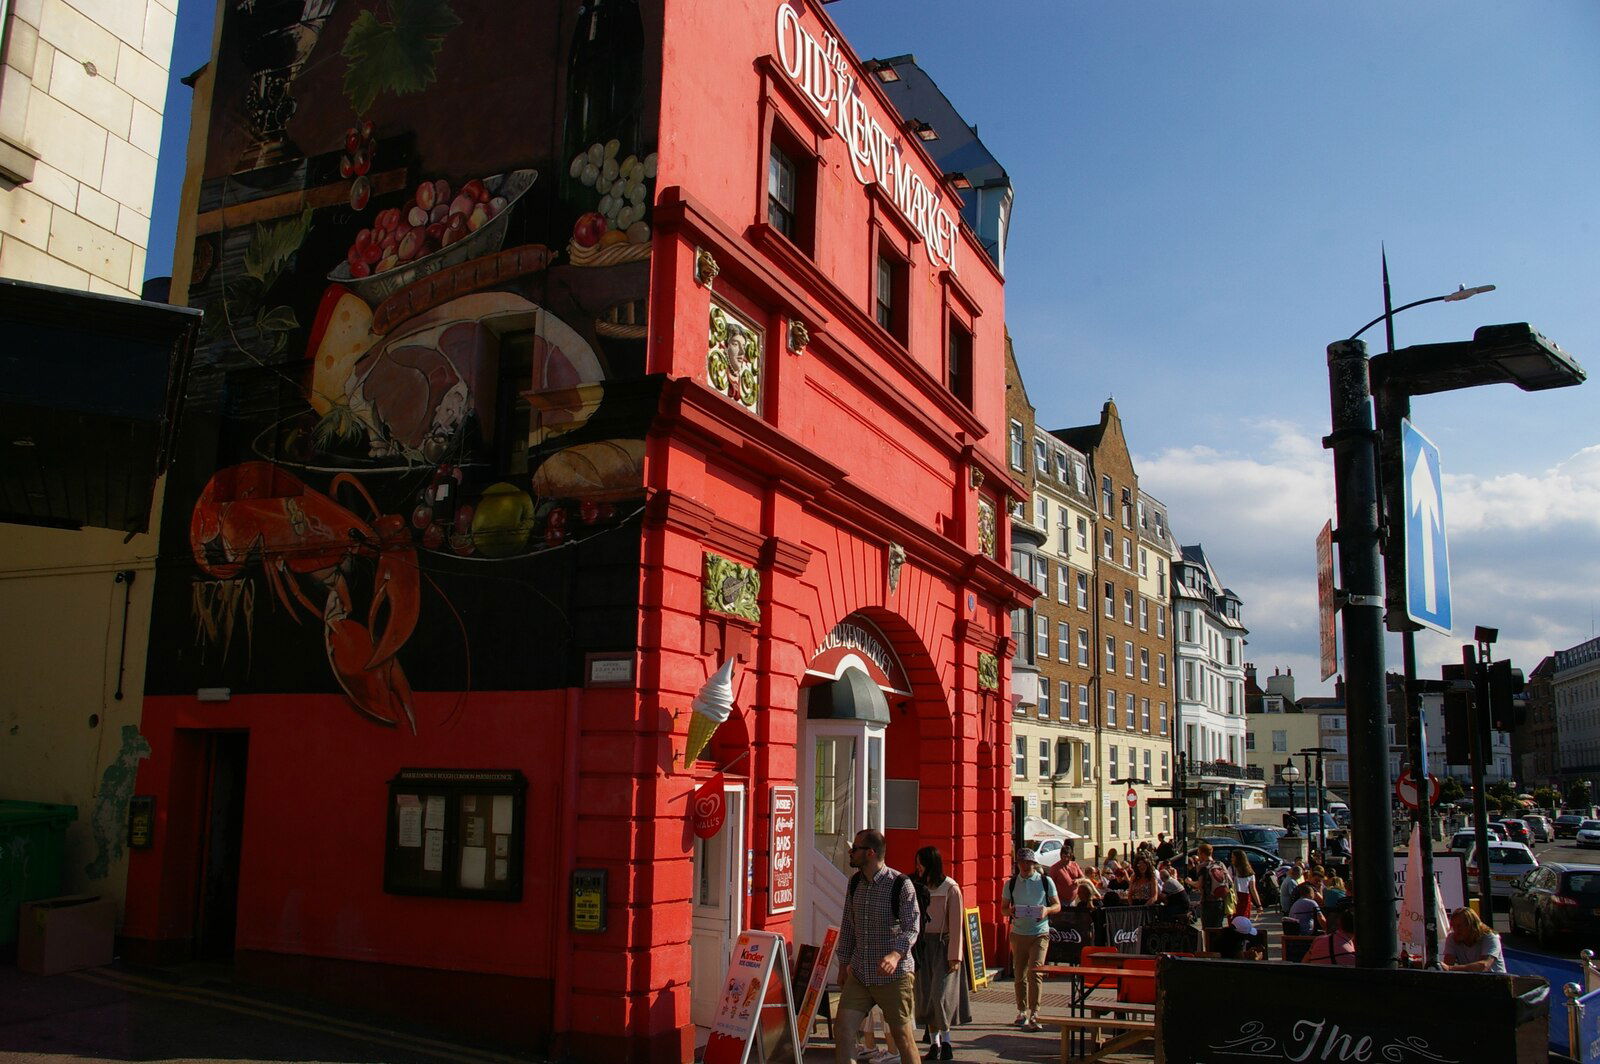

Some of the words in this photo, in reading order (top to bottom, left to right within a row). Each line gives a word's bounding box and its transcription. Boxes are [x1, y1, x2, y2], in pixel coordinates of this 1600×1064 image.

[823, 31, 848, 75] The
[776, 3, 831, 118] OLD
[833, 73, 892, 195] KENT
[890, 144, 959, 277] MARKET
[842, 623, 865, 652] KENT
[862, 631, 894, 681] MARKET
[695, 817, 720, 829] WALL'S
[775, 799, 792, 811] INSIDE
[776, 835, 791, 851] BARS
[1283, 1017, 1374, 1063] The
